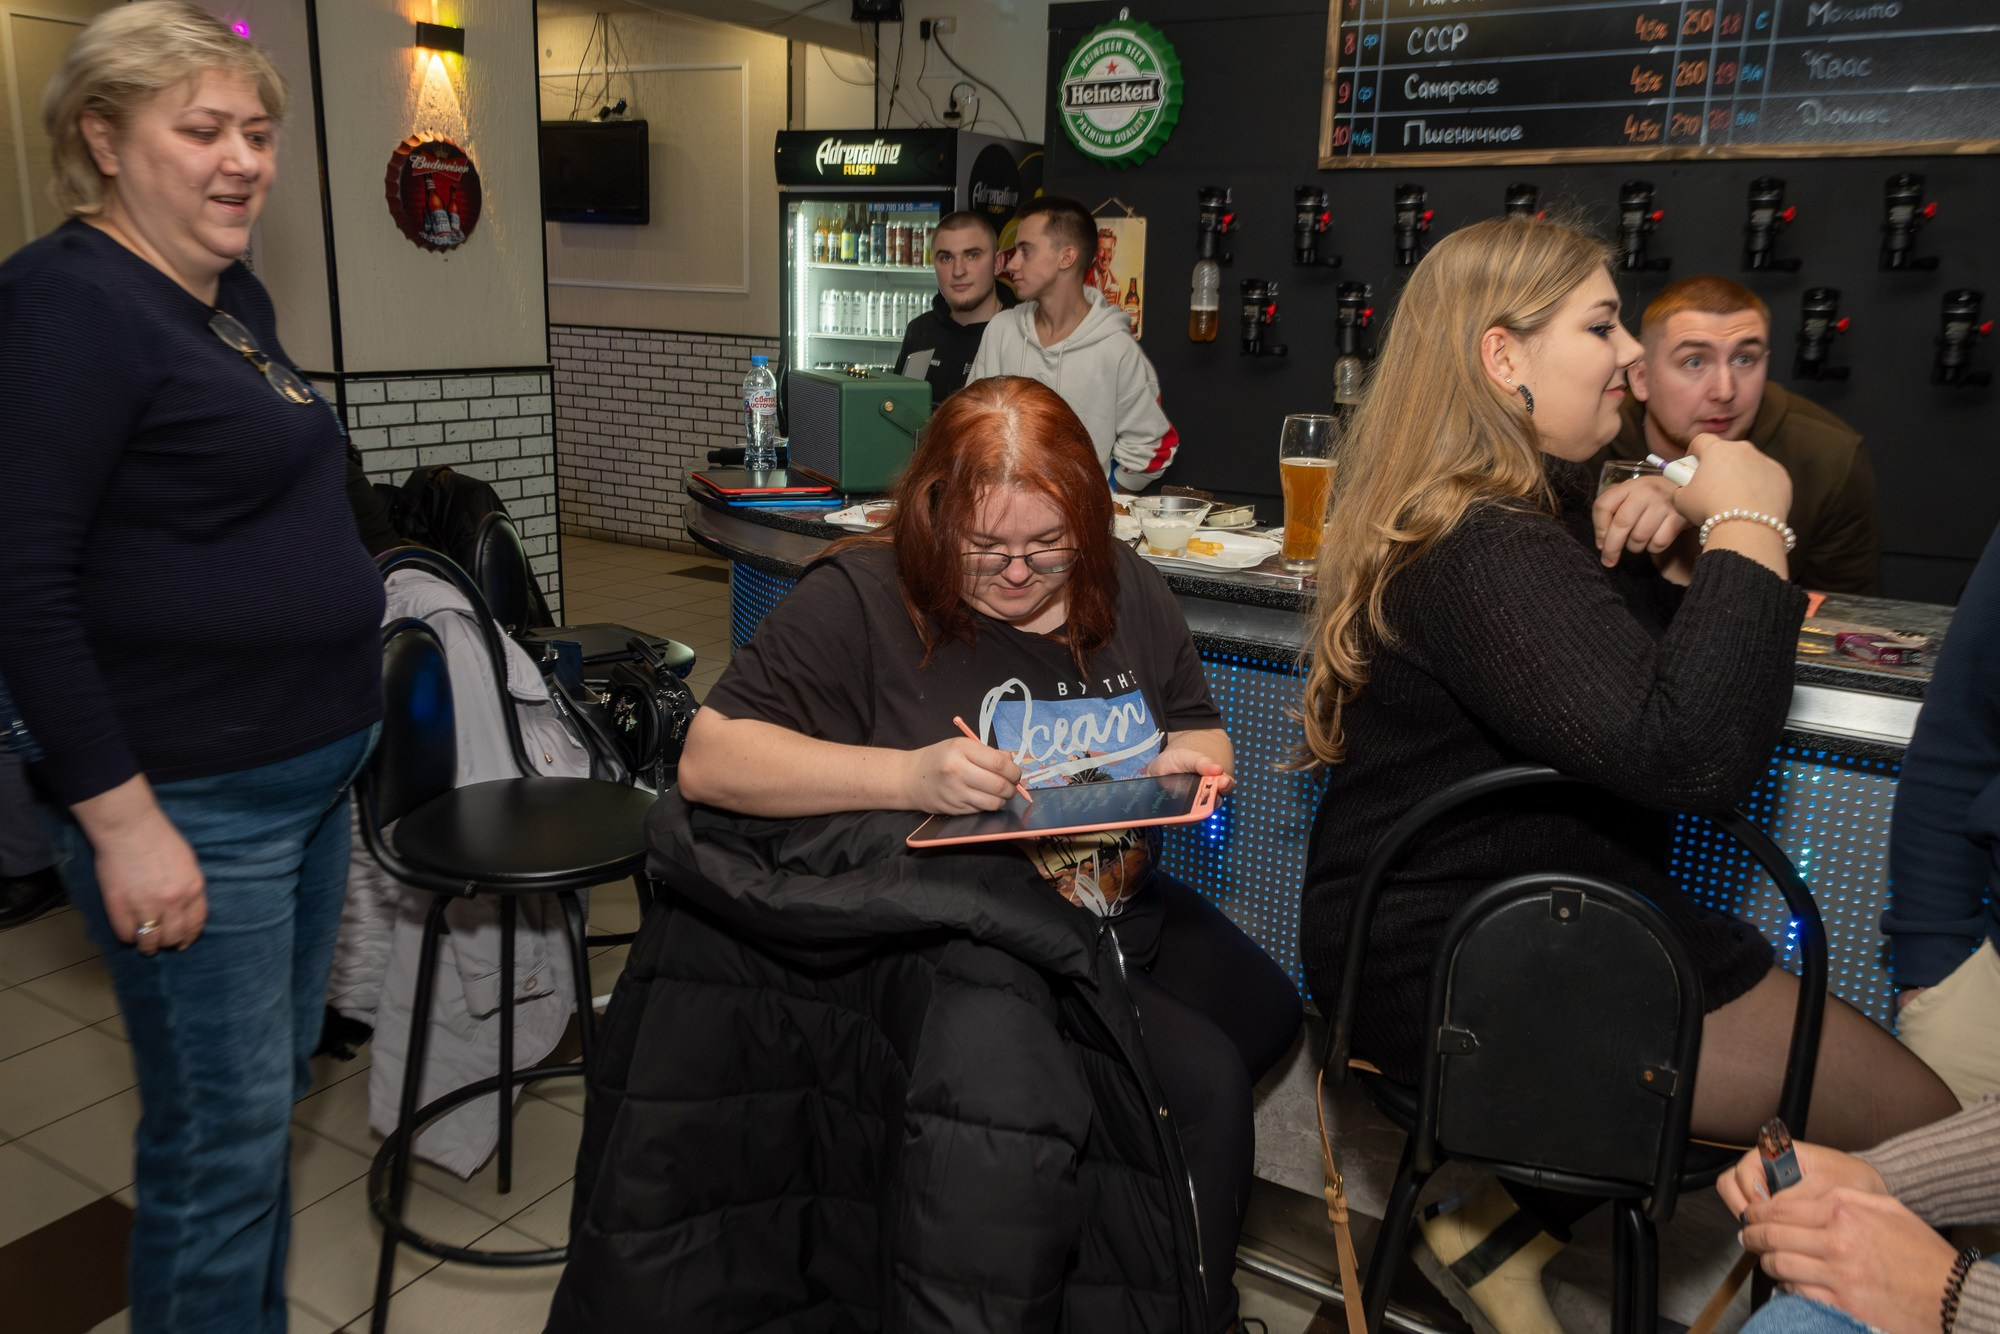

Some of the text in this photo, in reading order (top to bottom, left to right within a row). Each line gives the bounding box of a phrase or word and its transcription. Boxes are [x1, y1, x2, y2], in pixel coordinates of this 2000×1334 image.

[1344, 32, 1355, 55] 8
[1407, 22, 1469, 55] СССР
[1080, 40, 1146, 70] HEINEKEN BEER
[1070, 80, 1155, 105] Heineken
[1337, 81, 1351, 104] 9
[1404, 73, 1500, 103] Самарское
[1076, 113, 1148, 145] PREMIUM QUALITY
[1332, 125, 1350, 146] 10
[1403, 120, 1524, 146] Пшеничное
[409, 155, 470, 173] Budweiser
[816, 137, 901, 175] Adrenaline
[843, 164, 876, 175] RUSH
[979, 677, 1146, 766] Ocean
